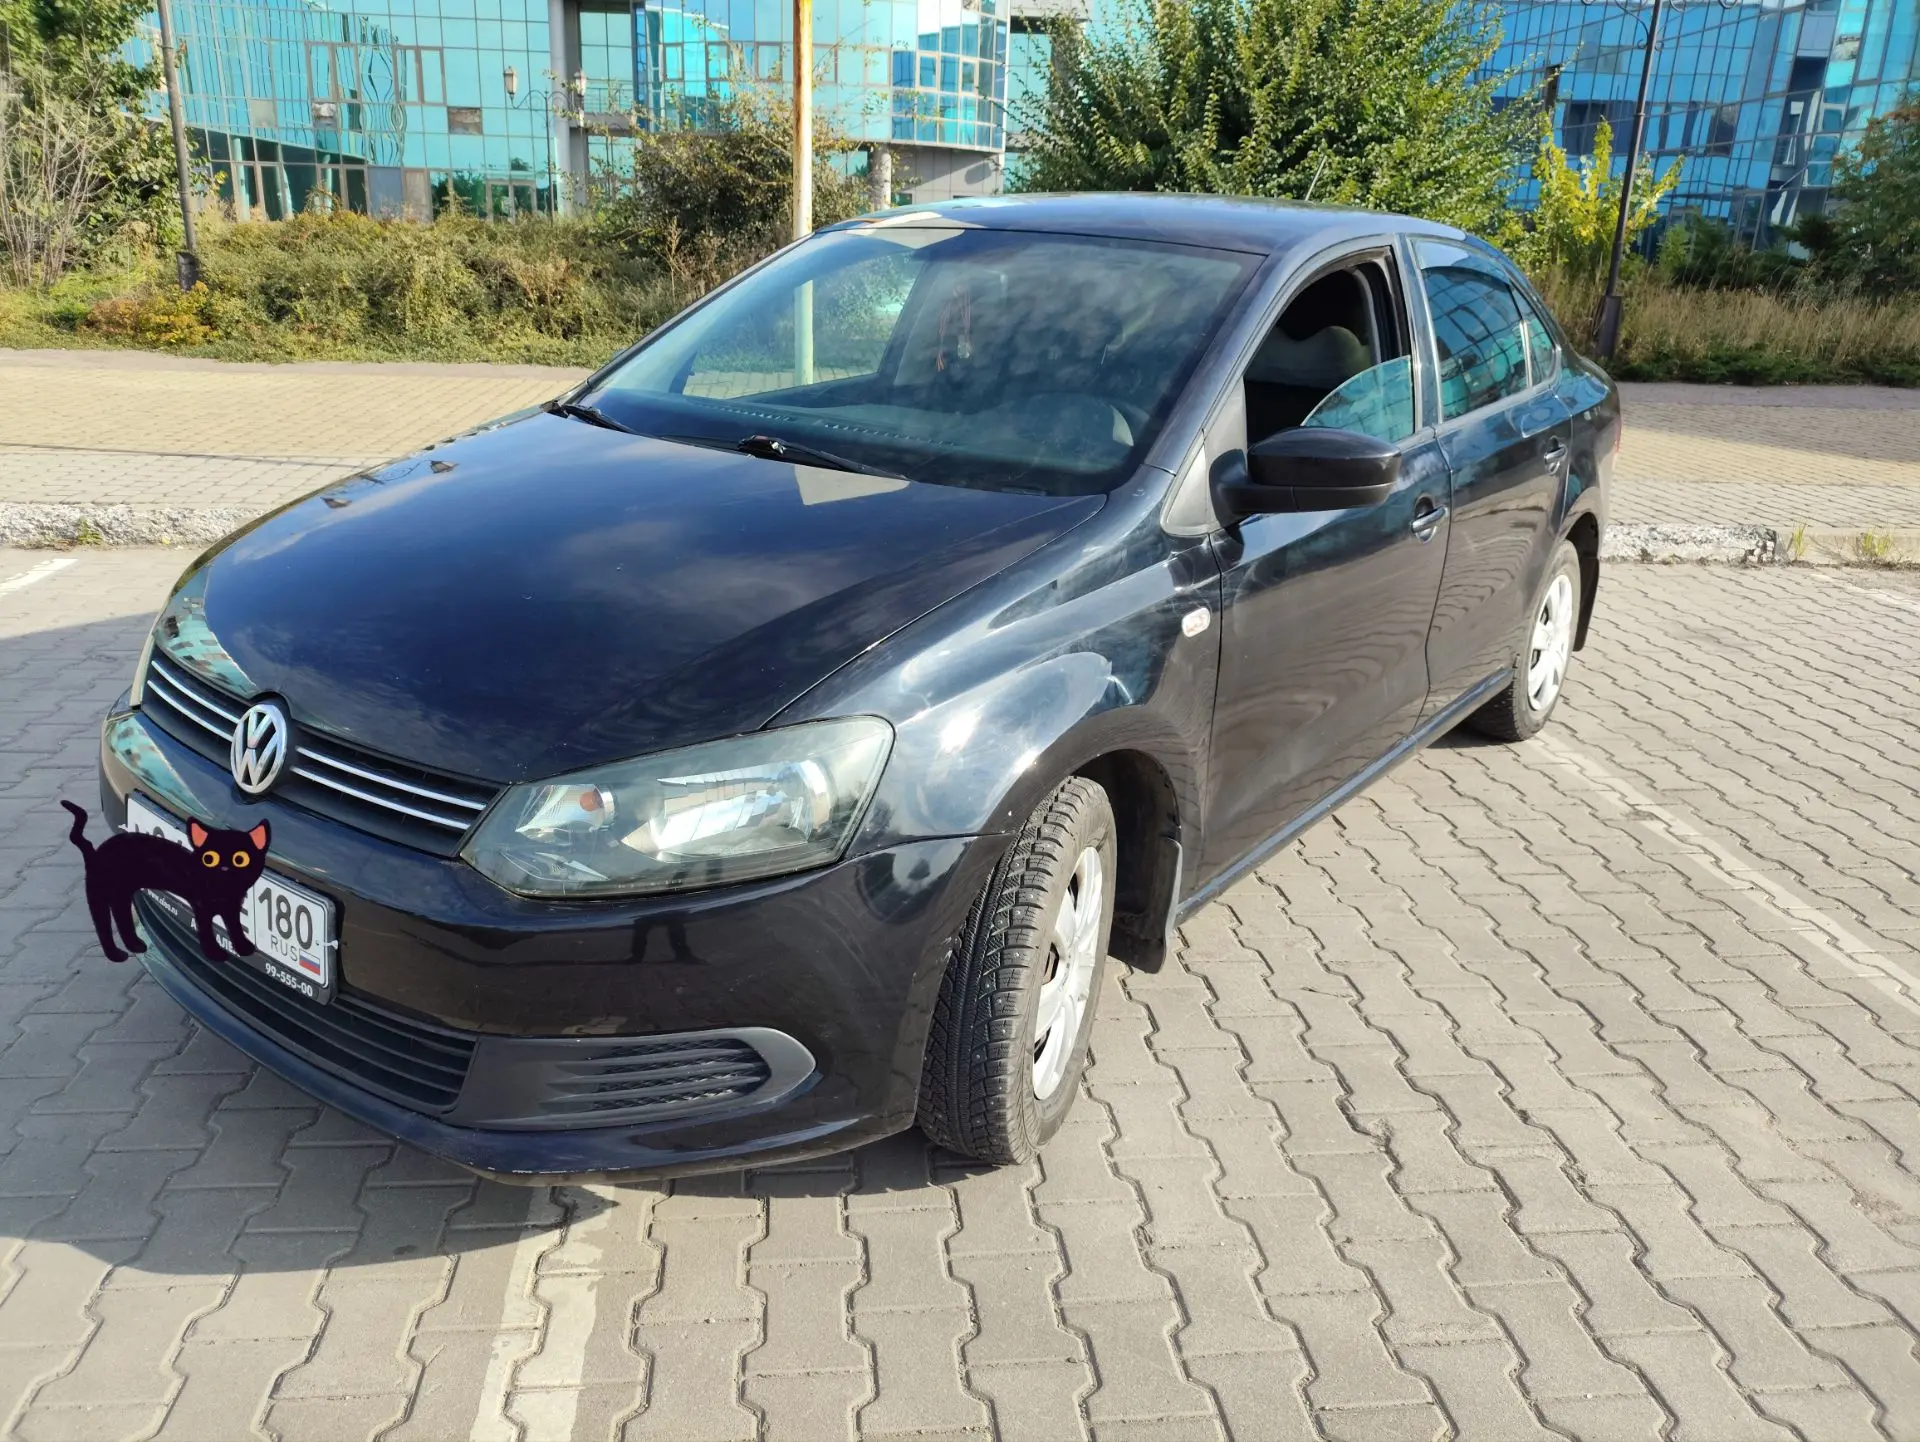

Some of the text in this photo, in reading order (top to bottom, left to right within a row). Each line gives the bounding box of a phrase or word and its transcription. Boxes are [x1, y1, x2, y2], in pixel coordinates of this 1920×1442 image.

[258, 887, 313, 950] 180
[271, 935, 298, 962] RUS
[265, 963, 313, 997] 99-555-00
